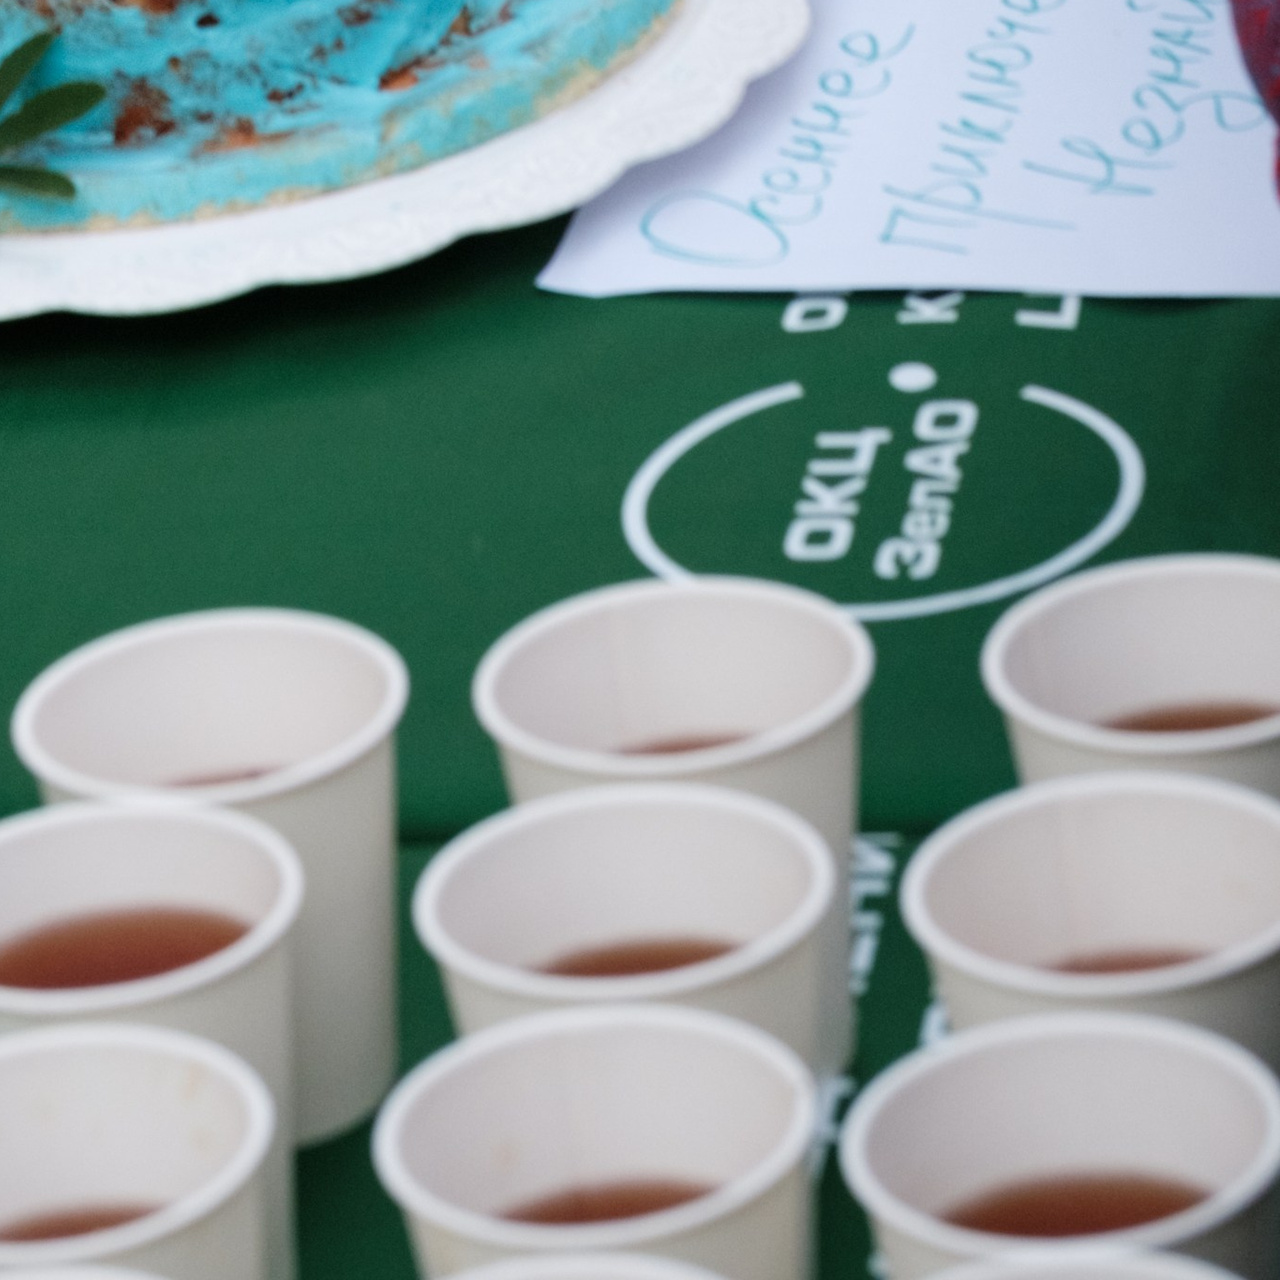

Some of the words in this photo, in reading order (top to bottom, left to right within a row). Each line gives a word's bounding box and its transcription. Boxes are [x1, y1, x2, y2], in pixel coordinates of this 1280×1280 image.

[639, 23, 916, 269] Осеннее
[782, 425, 894, 563] ОКЦ
[872, 397, 980, 581] ЗелАО
